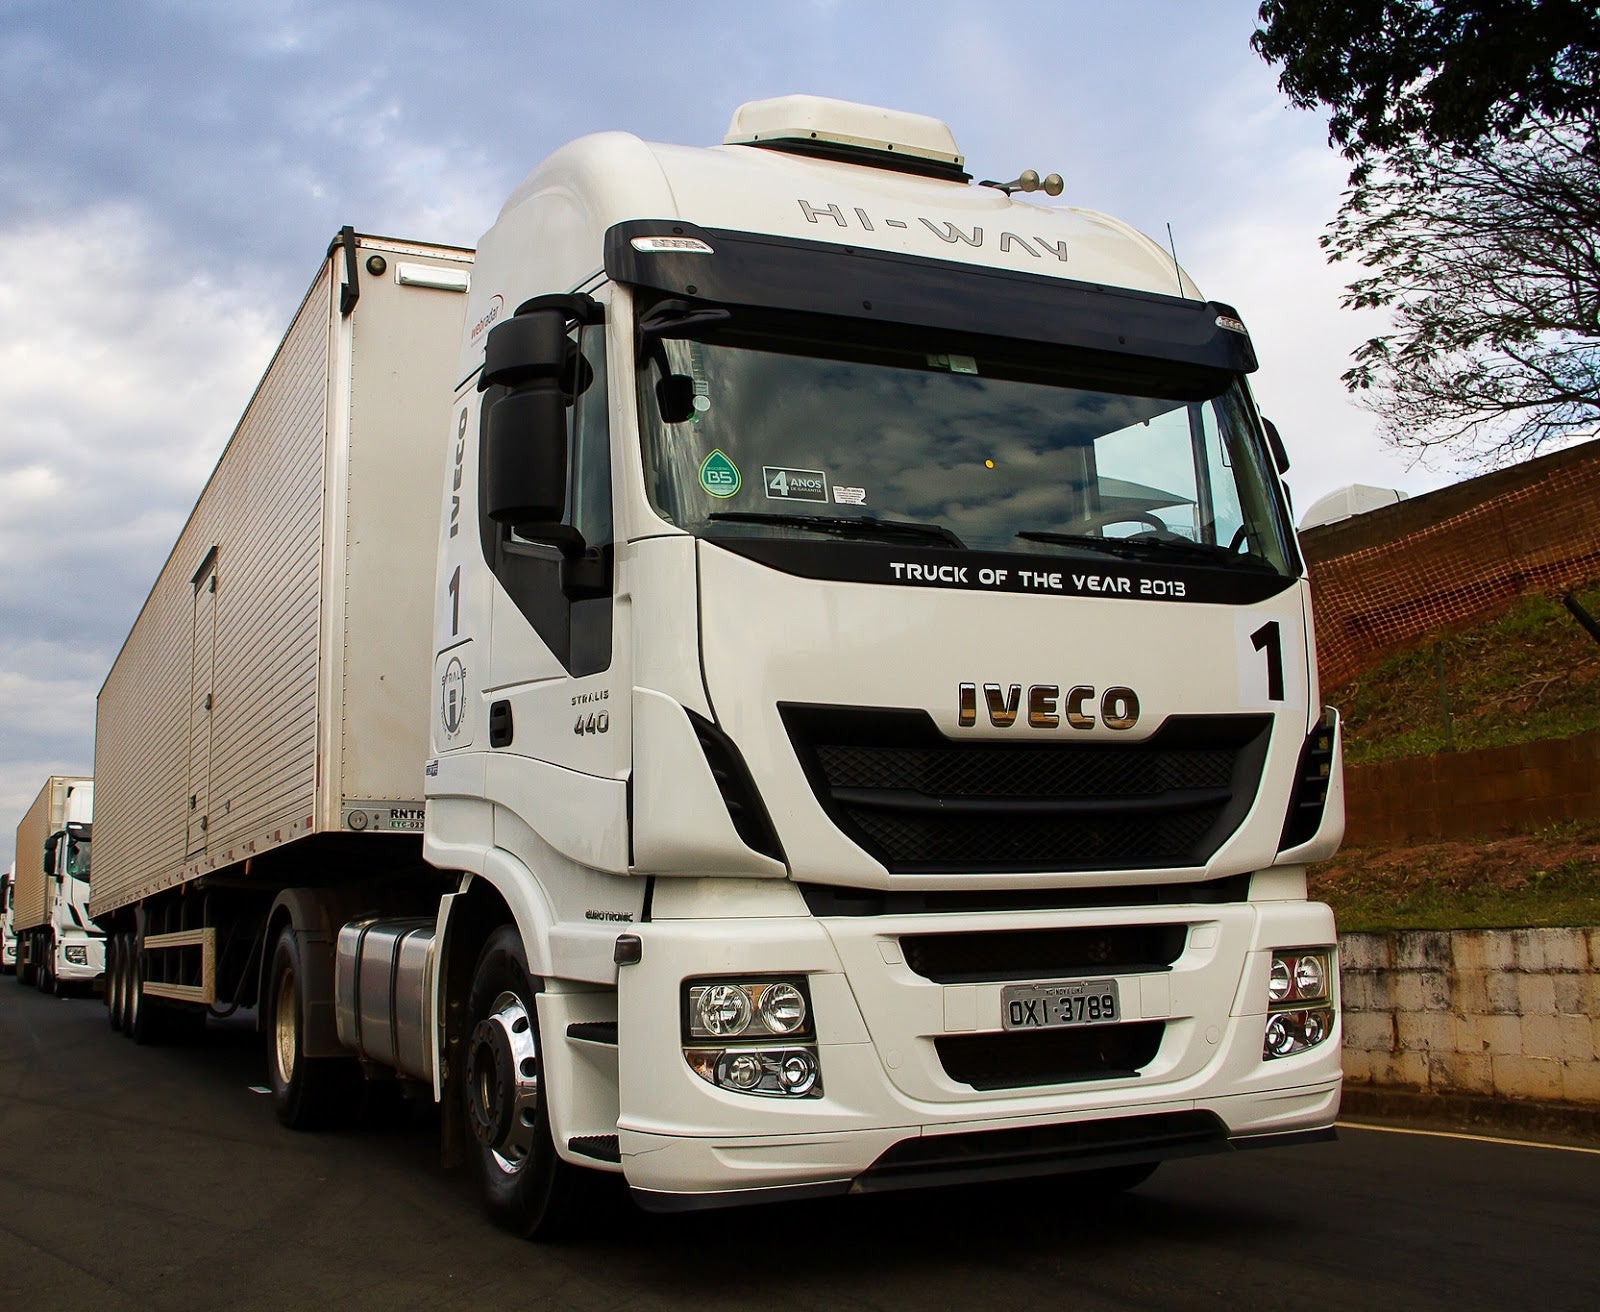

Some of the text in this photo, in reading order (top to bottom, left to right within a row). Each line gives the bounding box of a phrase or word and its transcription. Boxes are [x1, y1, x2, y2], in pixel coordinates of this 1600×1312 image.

[450, 407, 468, 539] IVECO
[706, 470, 733, 484] B5
[769, 471, 822, 496] 4 ANOS
[890, 562, 1186, 597] TRUCK OF THE YEAR 2013
[448, 565, 461, 637] 1
[1249, 620, 1285, 702] 1
[571, 690, 609, 706] STRALIS
[958, 682, 1141, 730] IVECO
[573, 710, 609, 737] 440
